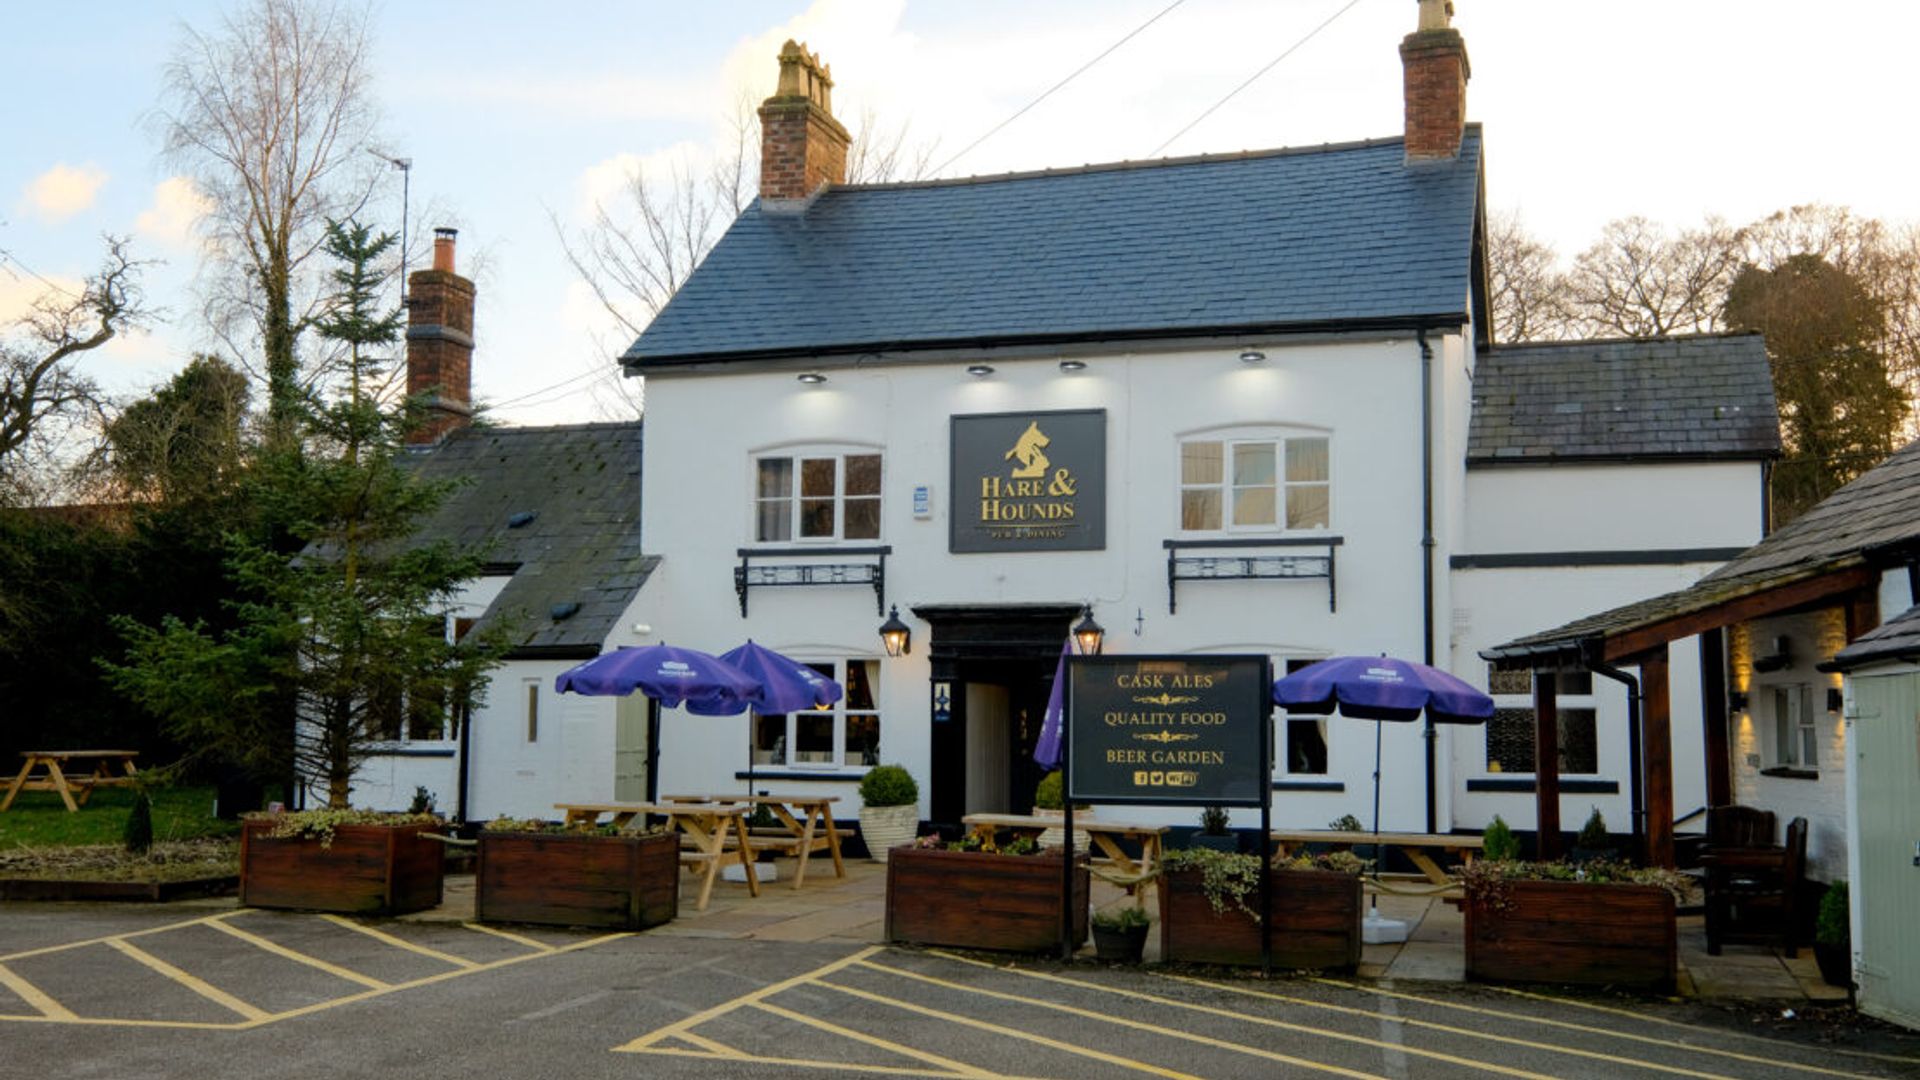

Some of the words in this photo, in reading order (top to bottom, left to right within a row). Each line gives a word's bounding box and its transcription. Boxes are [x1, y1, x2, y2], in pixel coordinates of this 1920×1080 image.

[981, 477, 1045, 498] HARE
[1048, 468, 1078, 497] &
[981, 499, 1075, 521] HOUNDS
[1117, 674, 1164, 688] CASK
[1171, 674, 1213, 688] ALES
[1104, 712, 1177, 727] QUALITY
[1181, 712, 1226, 725] FOOD
[1106, 749, 1147, 763] BEER
[1151, 750, 1224, 764] GARDEN
